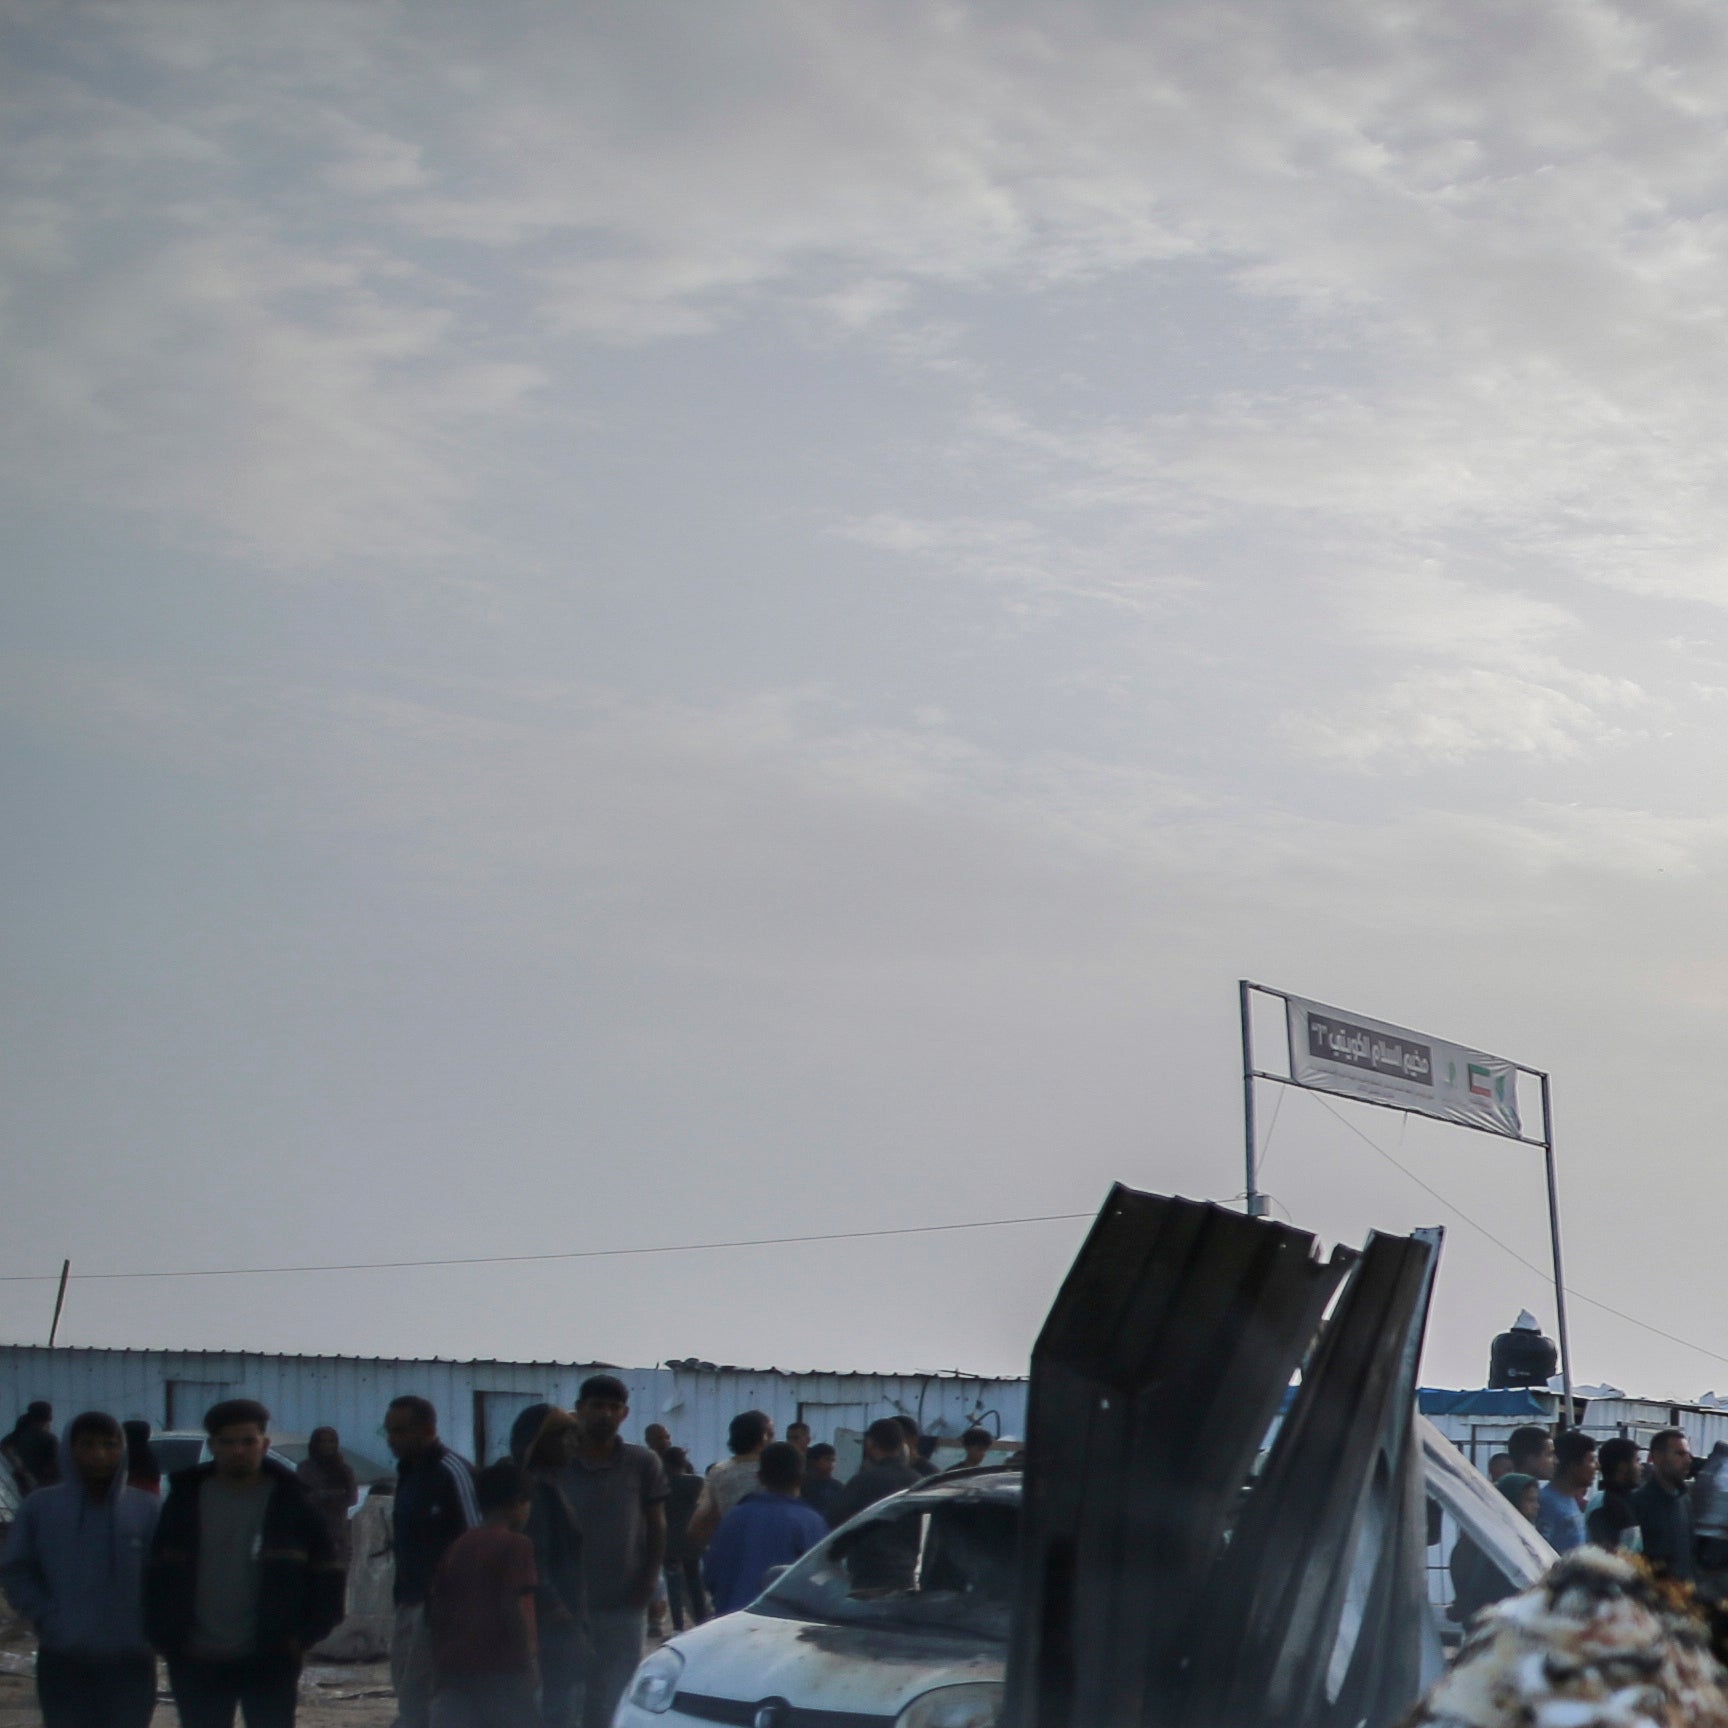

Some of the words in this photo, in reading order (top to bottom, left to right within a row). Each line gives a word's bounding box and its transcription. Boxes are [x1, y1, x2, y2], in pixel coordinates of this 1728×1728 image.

[1328, 1028, 1371, 1061] الكويتي
[1371, 1039, 1403, 1068] السلام
[1403, 1049, 1430, 1078] مخيم
